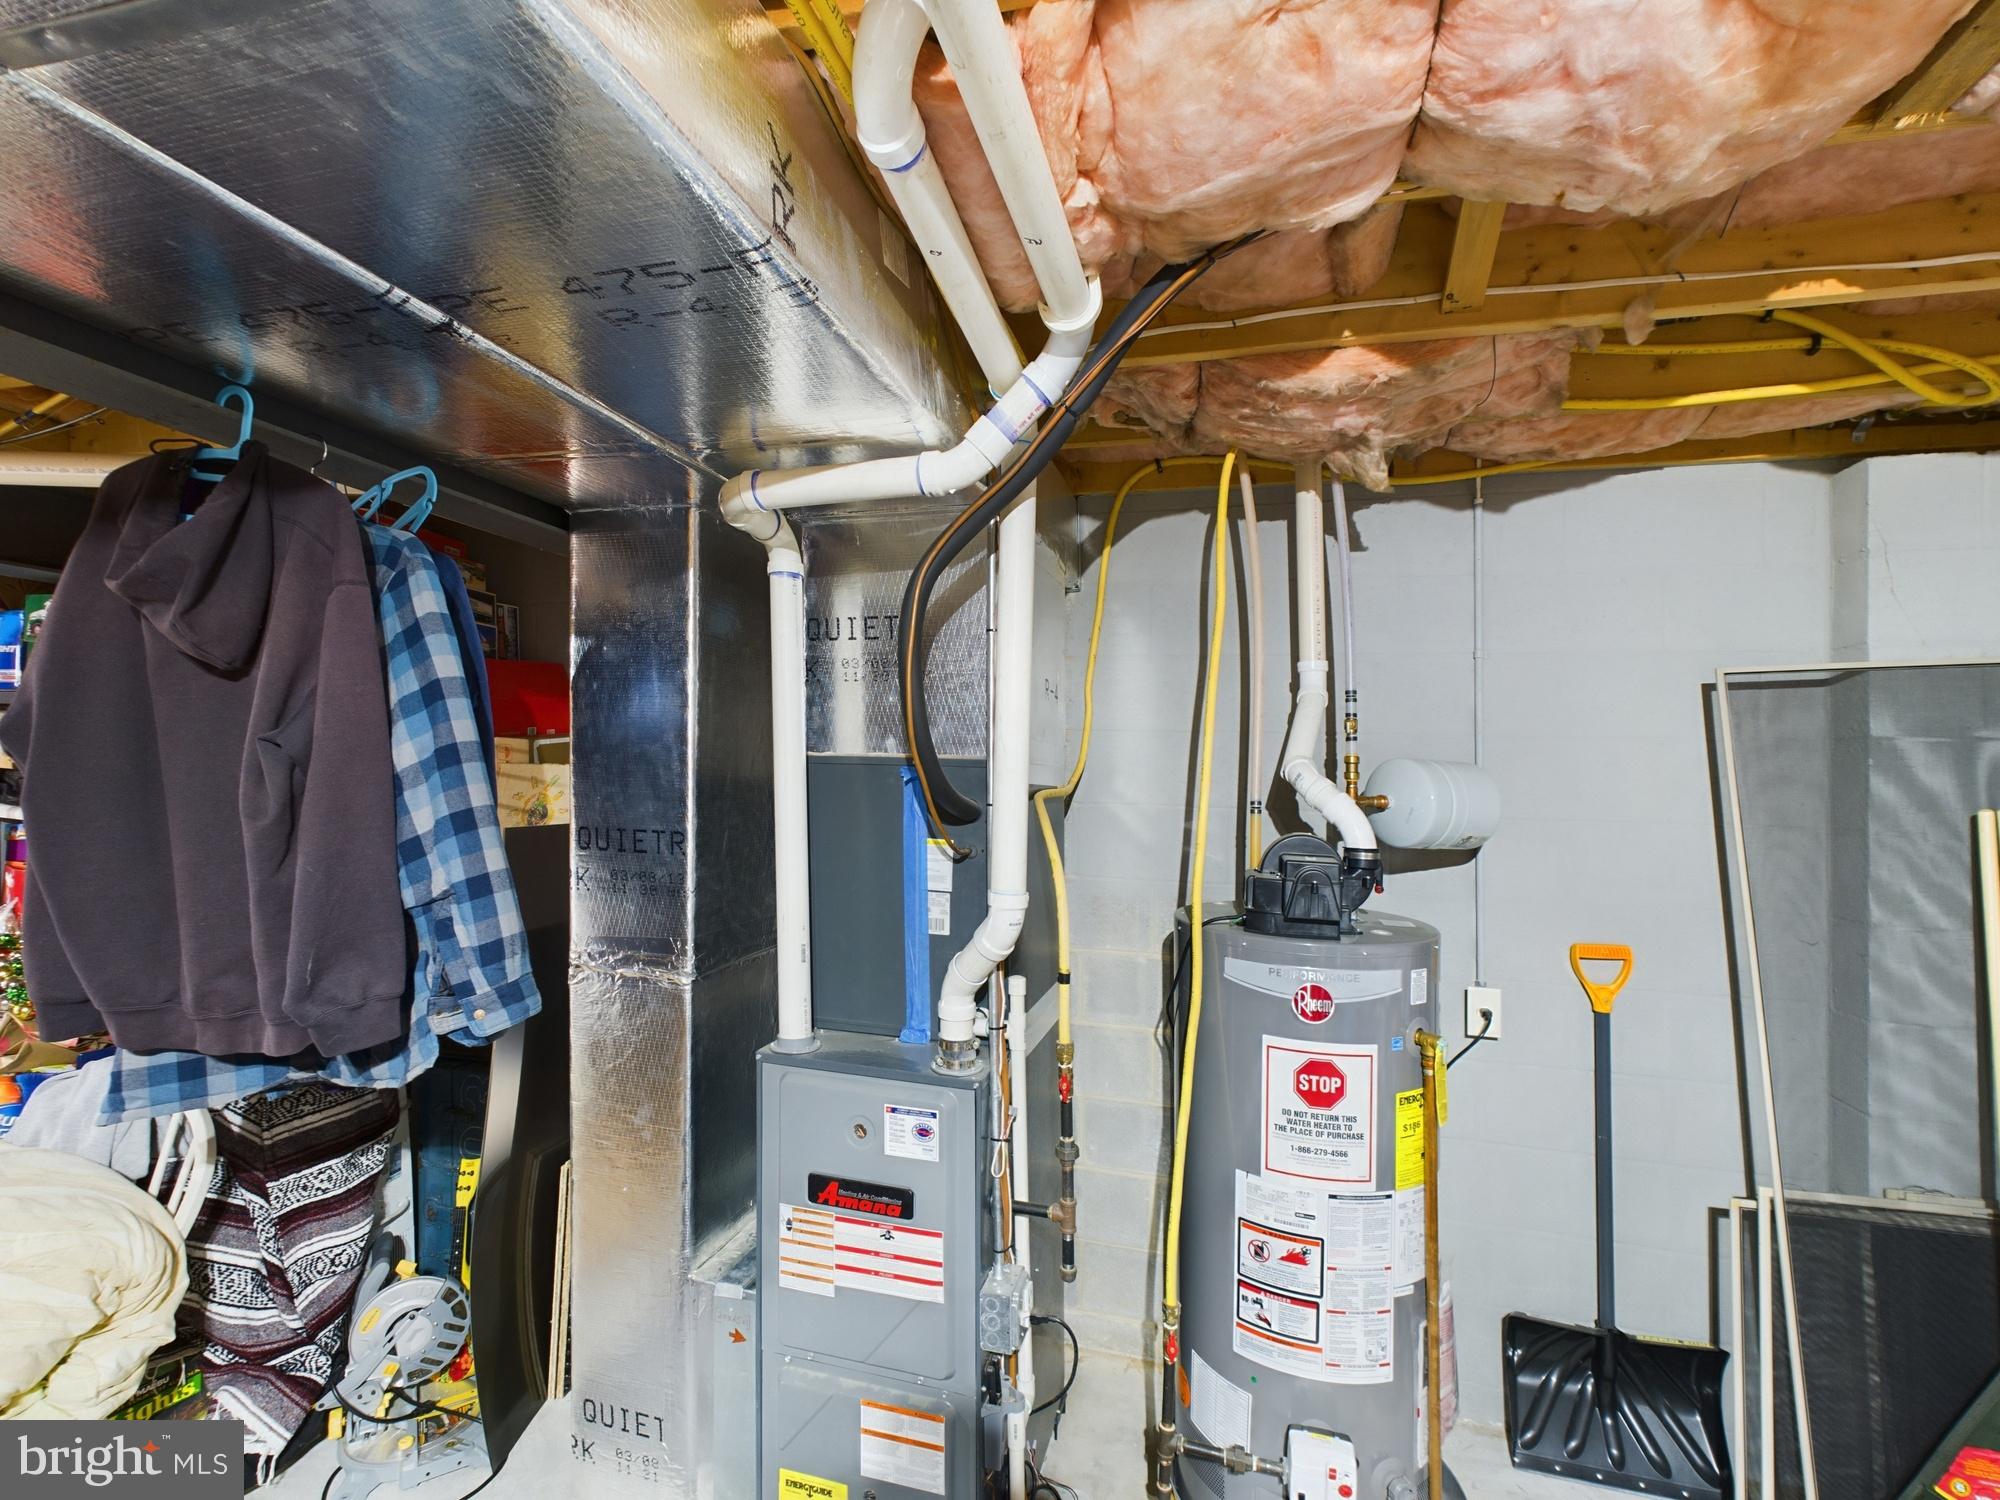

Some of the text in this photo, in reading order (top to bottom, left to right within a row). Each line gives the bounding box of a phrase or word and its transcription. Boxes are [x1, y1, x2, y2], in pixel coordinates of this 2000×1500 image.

[806, 615, 899, 641] QUIET
[575, 866, 591, 892] K
[1268, 967, 1360, 983] PERFORMANCE
[1298, 983, 1332, 1016] Rheem
[1298, 1073, 1342, 1094] STOP
[1281, 1108, 1358, 1123] DO NOT RETURN THIS
[1286, 1118, 1312, 1128] WATER
[1313, 1121, 1341, 1131] HEATER
[1274, 1123, 1365, 1141] THE PLACE OF PURCHASE
[1290, 1144, 1349, 1158] 1-866-279-4566
[817, 1181, 902, 1217] Amana
[583, 1398, 664, 1442] QUIET
